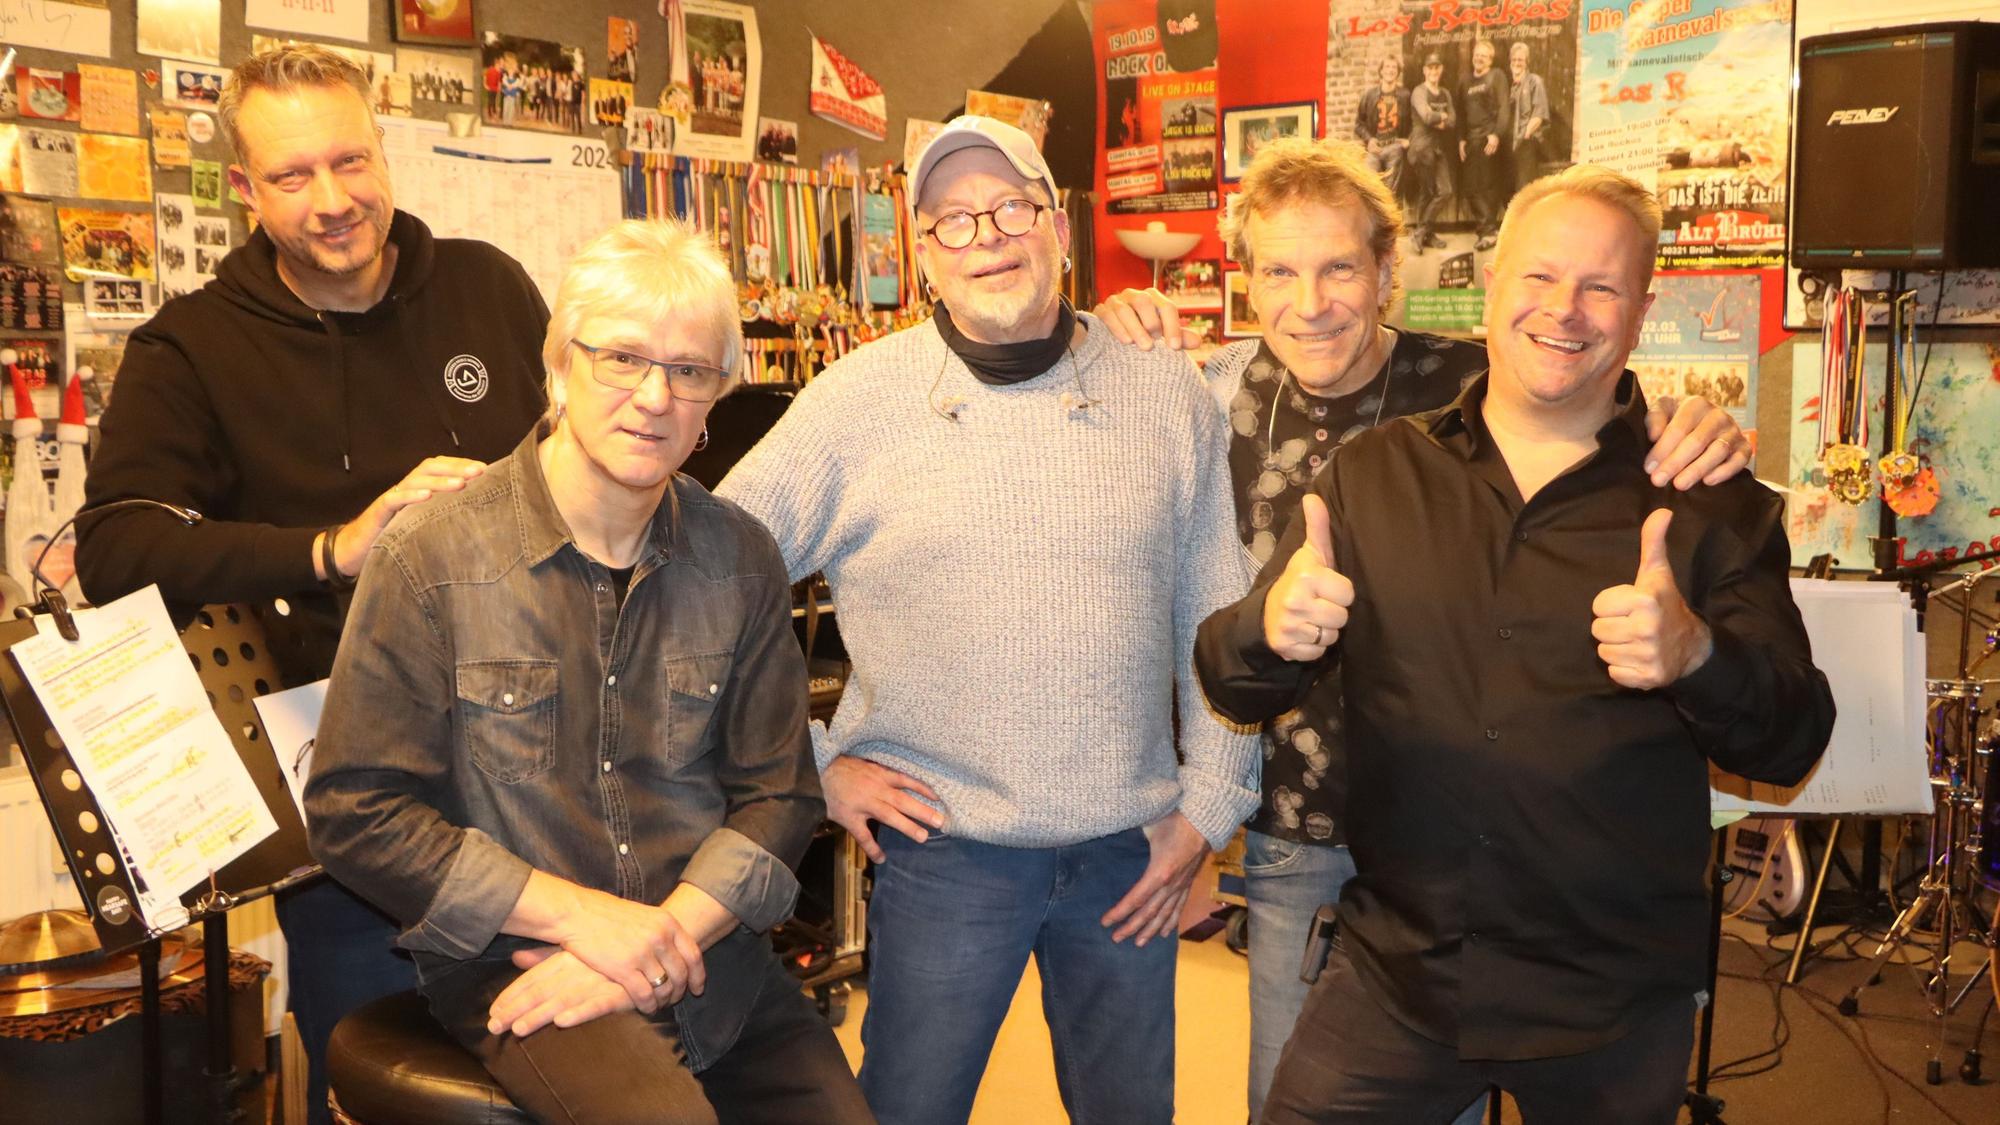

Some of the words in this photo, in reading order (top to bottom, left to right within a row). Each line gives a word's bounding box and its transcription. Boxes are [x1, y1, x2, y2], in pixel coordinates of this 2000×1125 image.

[1346, 14, 1413, 36] Los
[1422, 0, 1571, 30] Rockos
[1588, 8, 1623, 33] Die
[1628, 0, 1691, 24] Sper
[1107, 53, 1150, 79] ROCK
[1142, 84, 1164, 97] LIVE
[1167, 83, 1181, 96] ON
[1184, 80, 1216, 95] STAGE
[1826, 106, 1899, 126] PEAVEY
[1668, 186, 1695, 207] DAS
[1699, 185, 1720, 206] IST
[1722, 184, 1748, 205] DIE
[1689, 245, 1713, 255] Brühl
[1673, 255, 1784, 267] www.brauhausgarten.d
[1641, 320, 1680, 333] 02.03.
[1655, 332, 1681, 344] UHR
